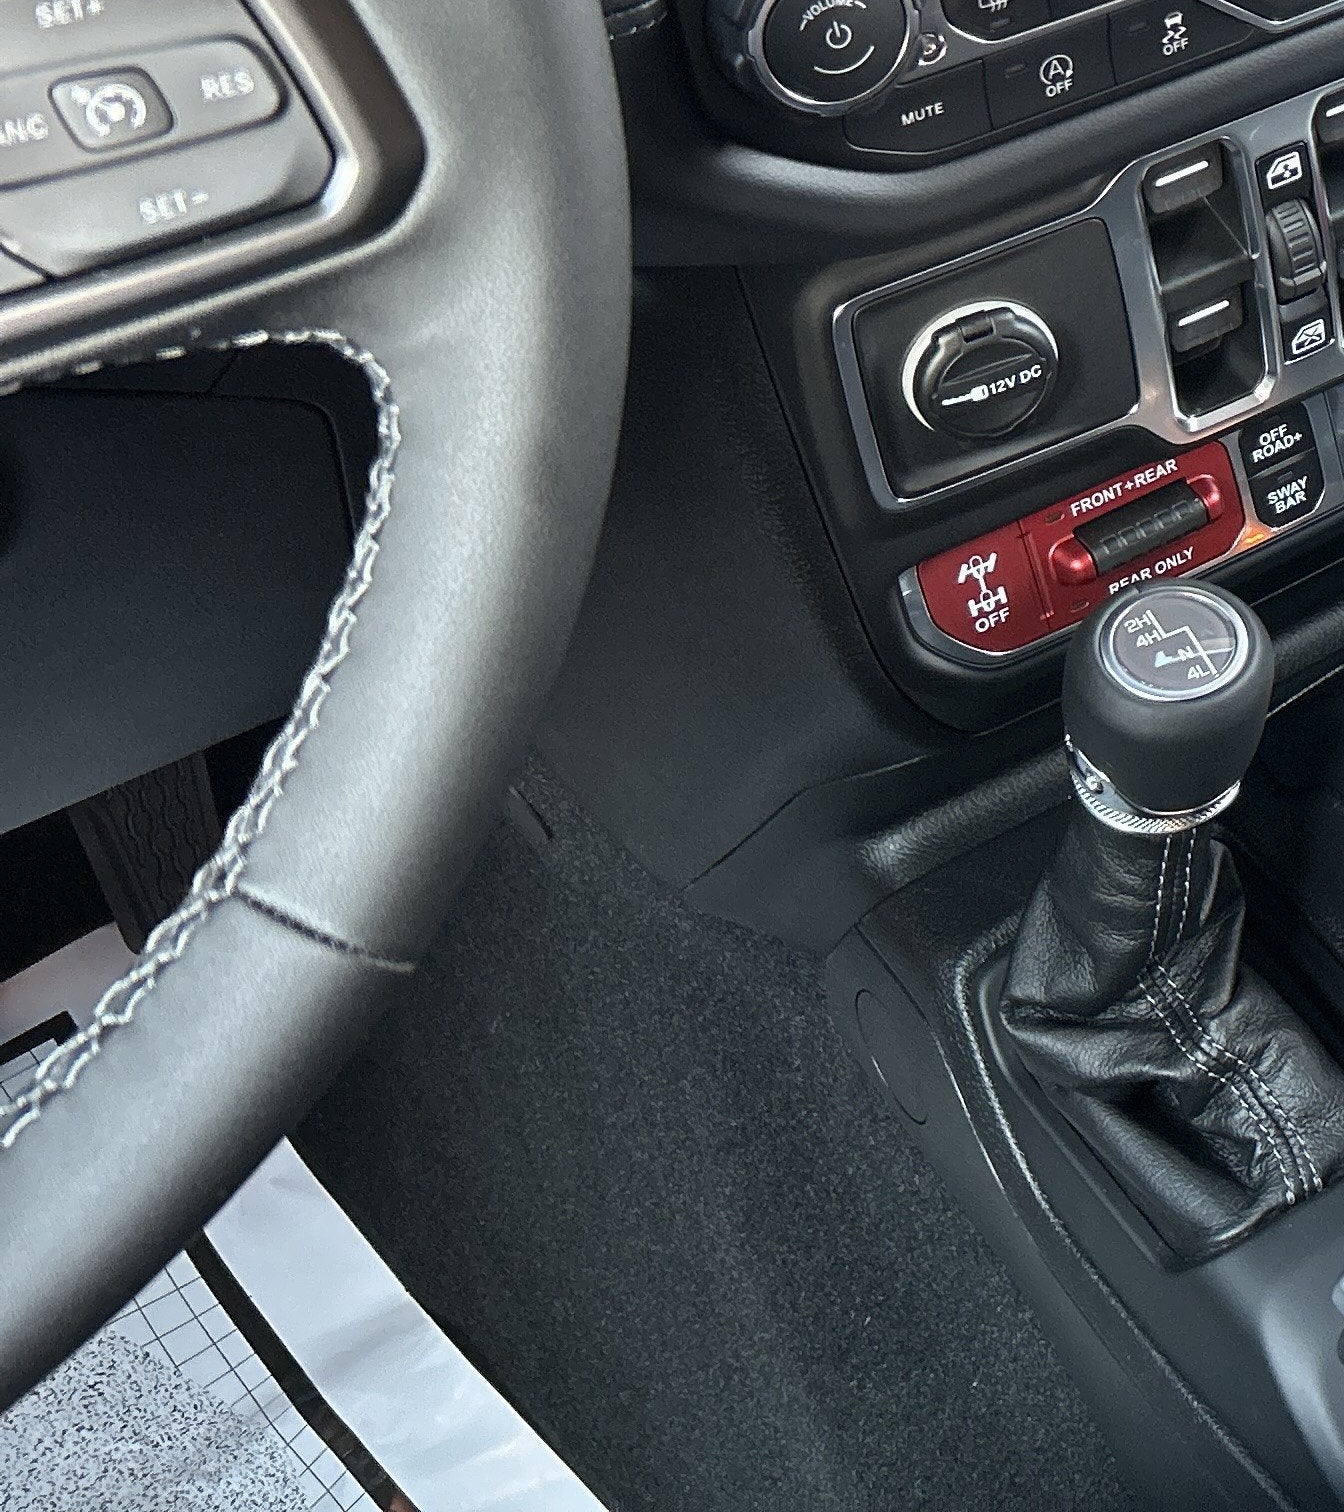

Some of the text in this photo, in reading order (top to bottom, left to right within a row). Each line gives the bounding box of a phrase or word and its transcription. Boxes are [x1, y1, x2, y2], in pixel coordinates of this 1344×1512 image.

[1162, 36, 1190, 57] OFF
[200, 71, 254, 103] RES
[1045, 77, 1074, 99] OFF
[901, 102, 945, 127] MUTE
[987, 363, 1043, 396] 12V DC
[1251, 431, 1304, 464] ROAD+
[1258, 424, 1289, 447] OFF
[1069, 458, 1179, 519] FRONT+REAR
[1266, 476, 1310, 505] SWAY
[1273, 489, 1308, 515] BAR
[1108, 546, 1195, 595] REAR ONLY
[974, 607, 1011, 634] OFF
[1124, 613, 1153, 634] 2H
[1135, 629, 1162, 648] 4H
[1177, 646, 1195, 661] N
[1187, 664, 1211, 680] 4L
